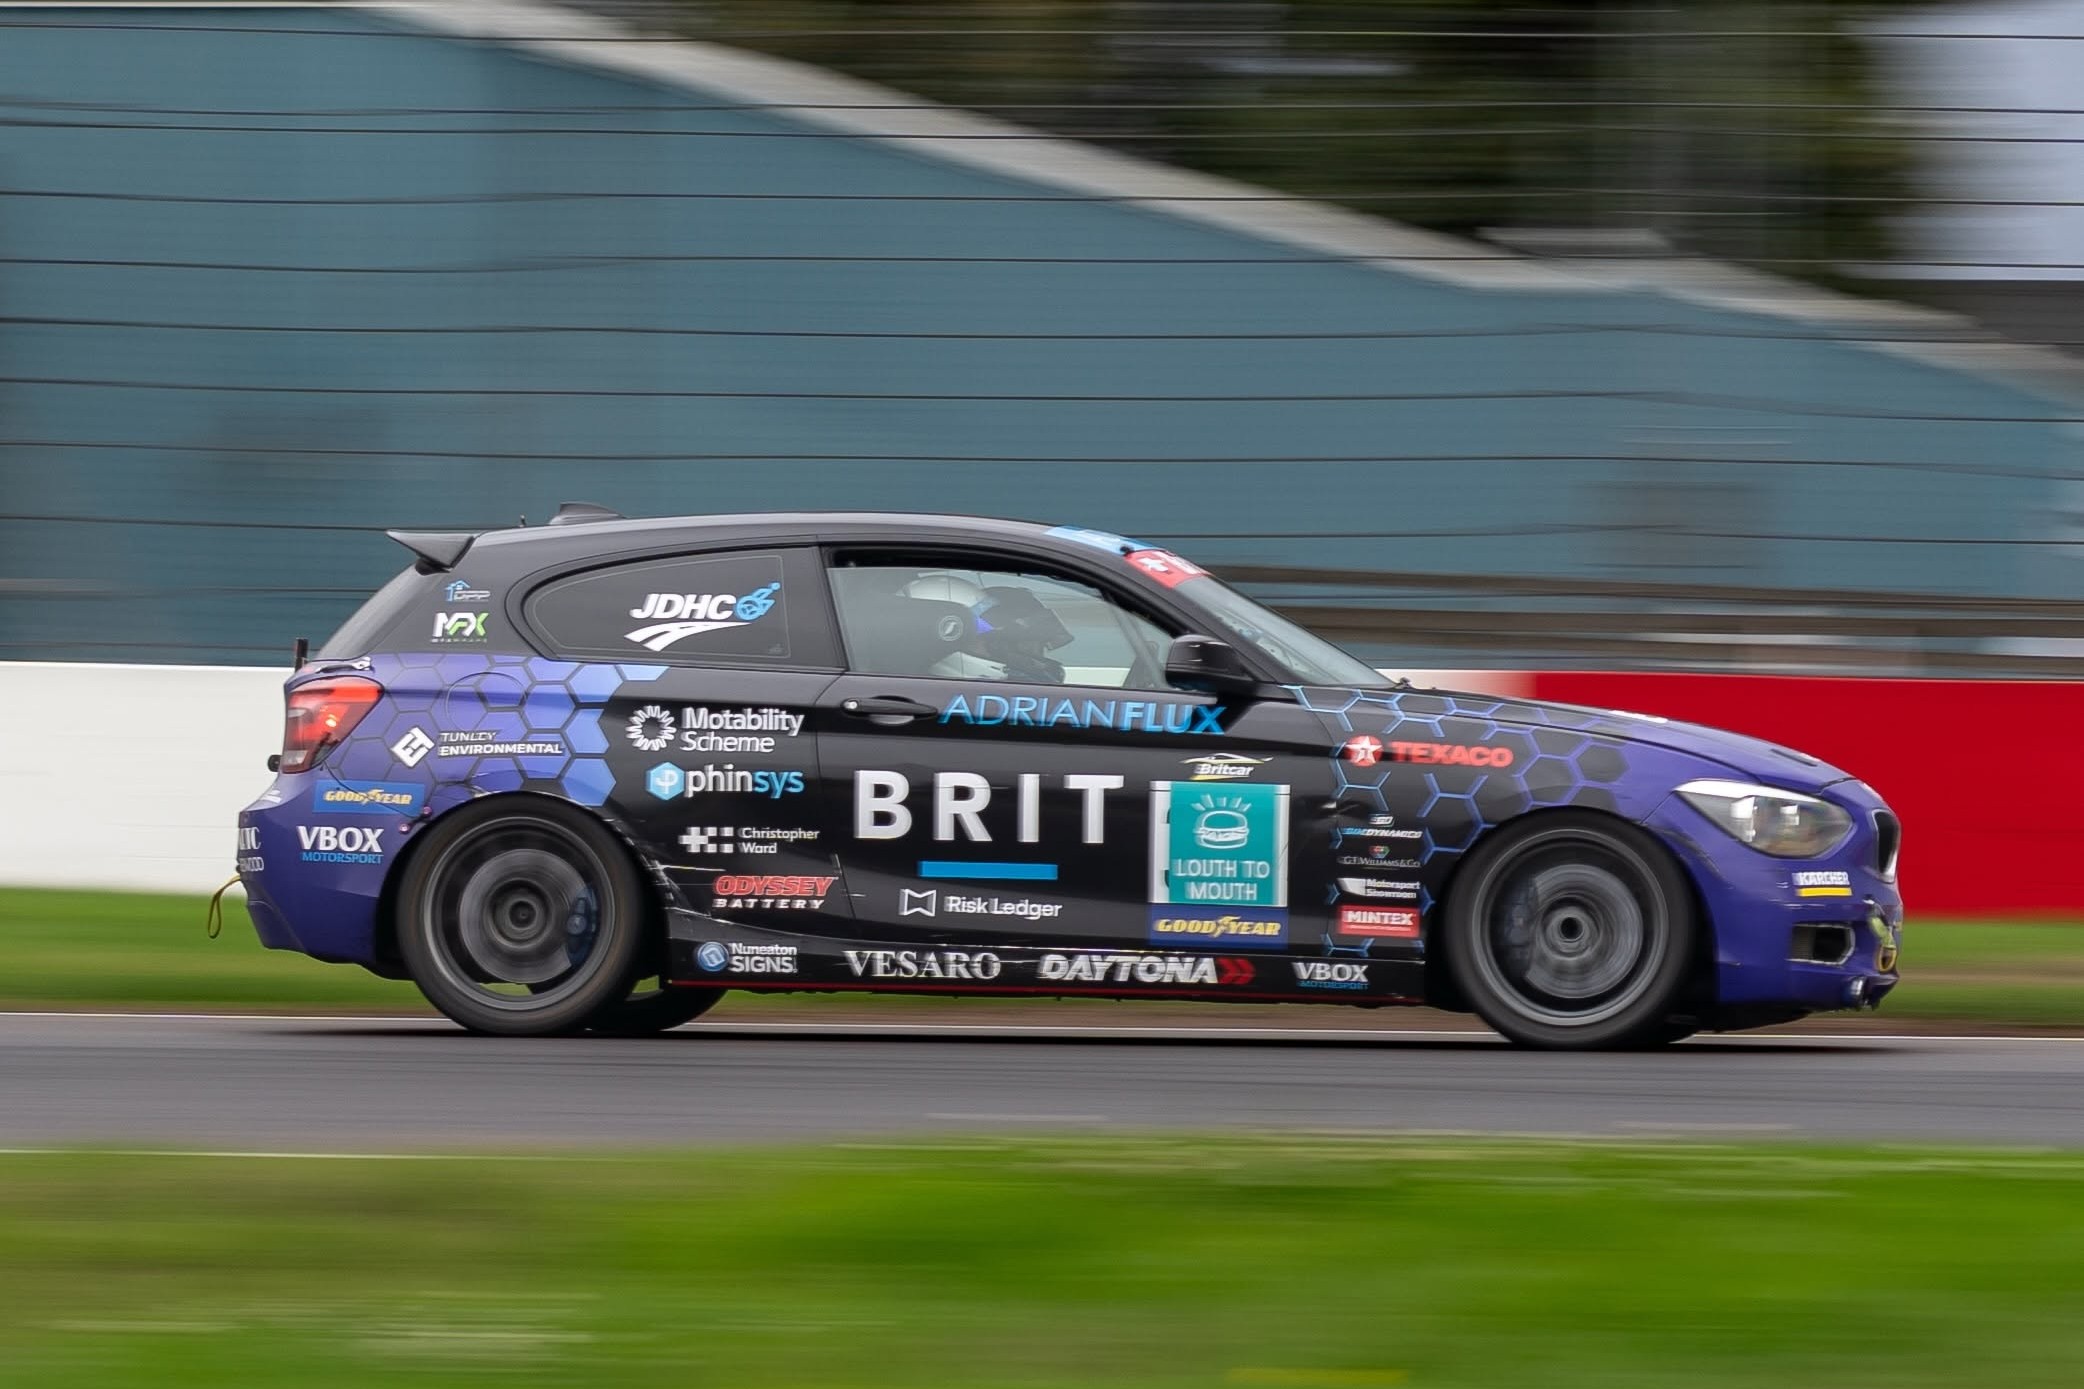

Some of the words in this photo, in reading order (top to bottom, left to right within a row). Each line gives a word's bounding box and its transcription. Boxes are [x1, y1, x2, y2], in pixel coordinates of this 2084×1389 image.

[630, 593, 737, 620] JDHC
[682, 708, 805, 736] Motability
[439, 742, 563, 757] ENVIRONMENTAL
[680, 731, 775, 752] Scheme
[1391, 741, 1514, 768] TEXACO
[1194, 763, 1254, 776] Britcar
[685, 764, 805, 799] phinsys
[324, 787, 413, 805] GOODYEAR
[853, 769, 1124, 844] BRIT
[296, 825, 385, 853] VBOX
[737, 827, 820, 840] Christopher
[301, 852, 384, 864] MOTORSPORT
[738, 843, 778, 854] Ward
[1172, 859, 1237, 878] LOUTH
[1241, 860, 1270, 879] TO
[712, 875, 834, 897] ODYSSEY
[1185, 882, 1258, 901] MOUTH
[712, 898, 825, 909] BATTERY
[943, 896, 988, 915] Risk
[986, 898, 1063, 920] Ledger
[1154, 916, 1282, 937] GOODYEAR
[1343, 909, 1414, 927] MINTEX
[731, 943, 797, 956] Nuneaton
[842, 950, 1002, 980] VESARO
[1036, 954, 1219, 984] DAYTONA
[1291, 961, 1369, 983] VBOX
